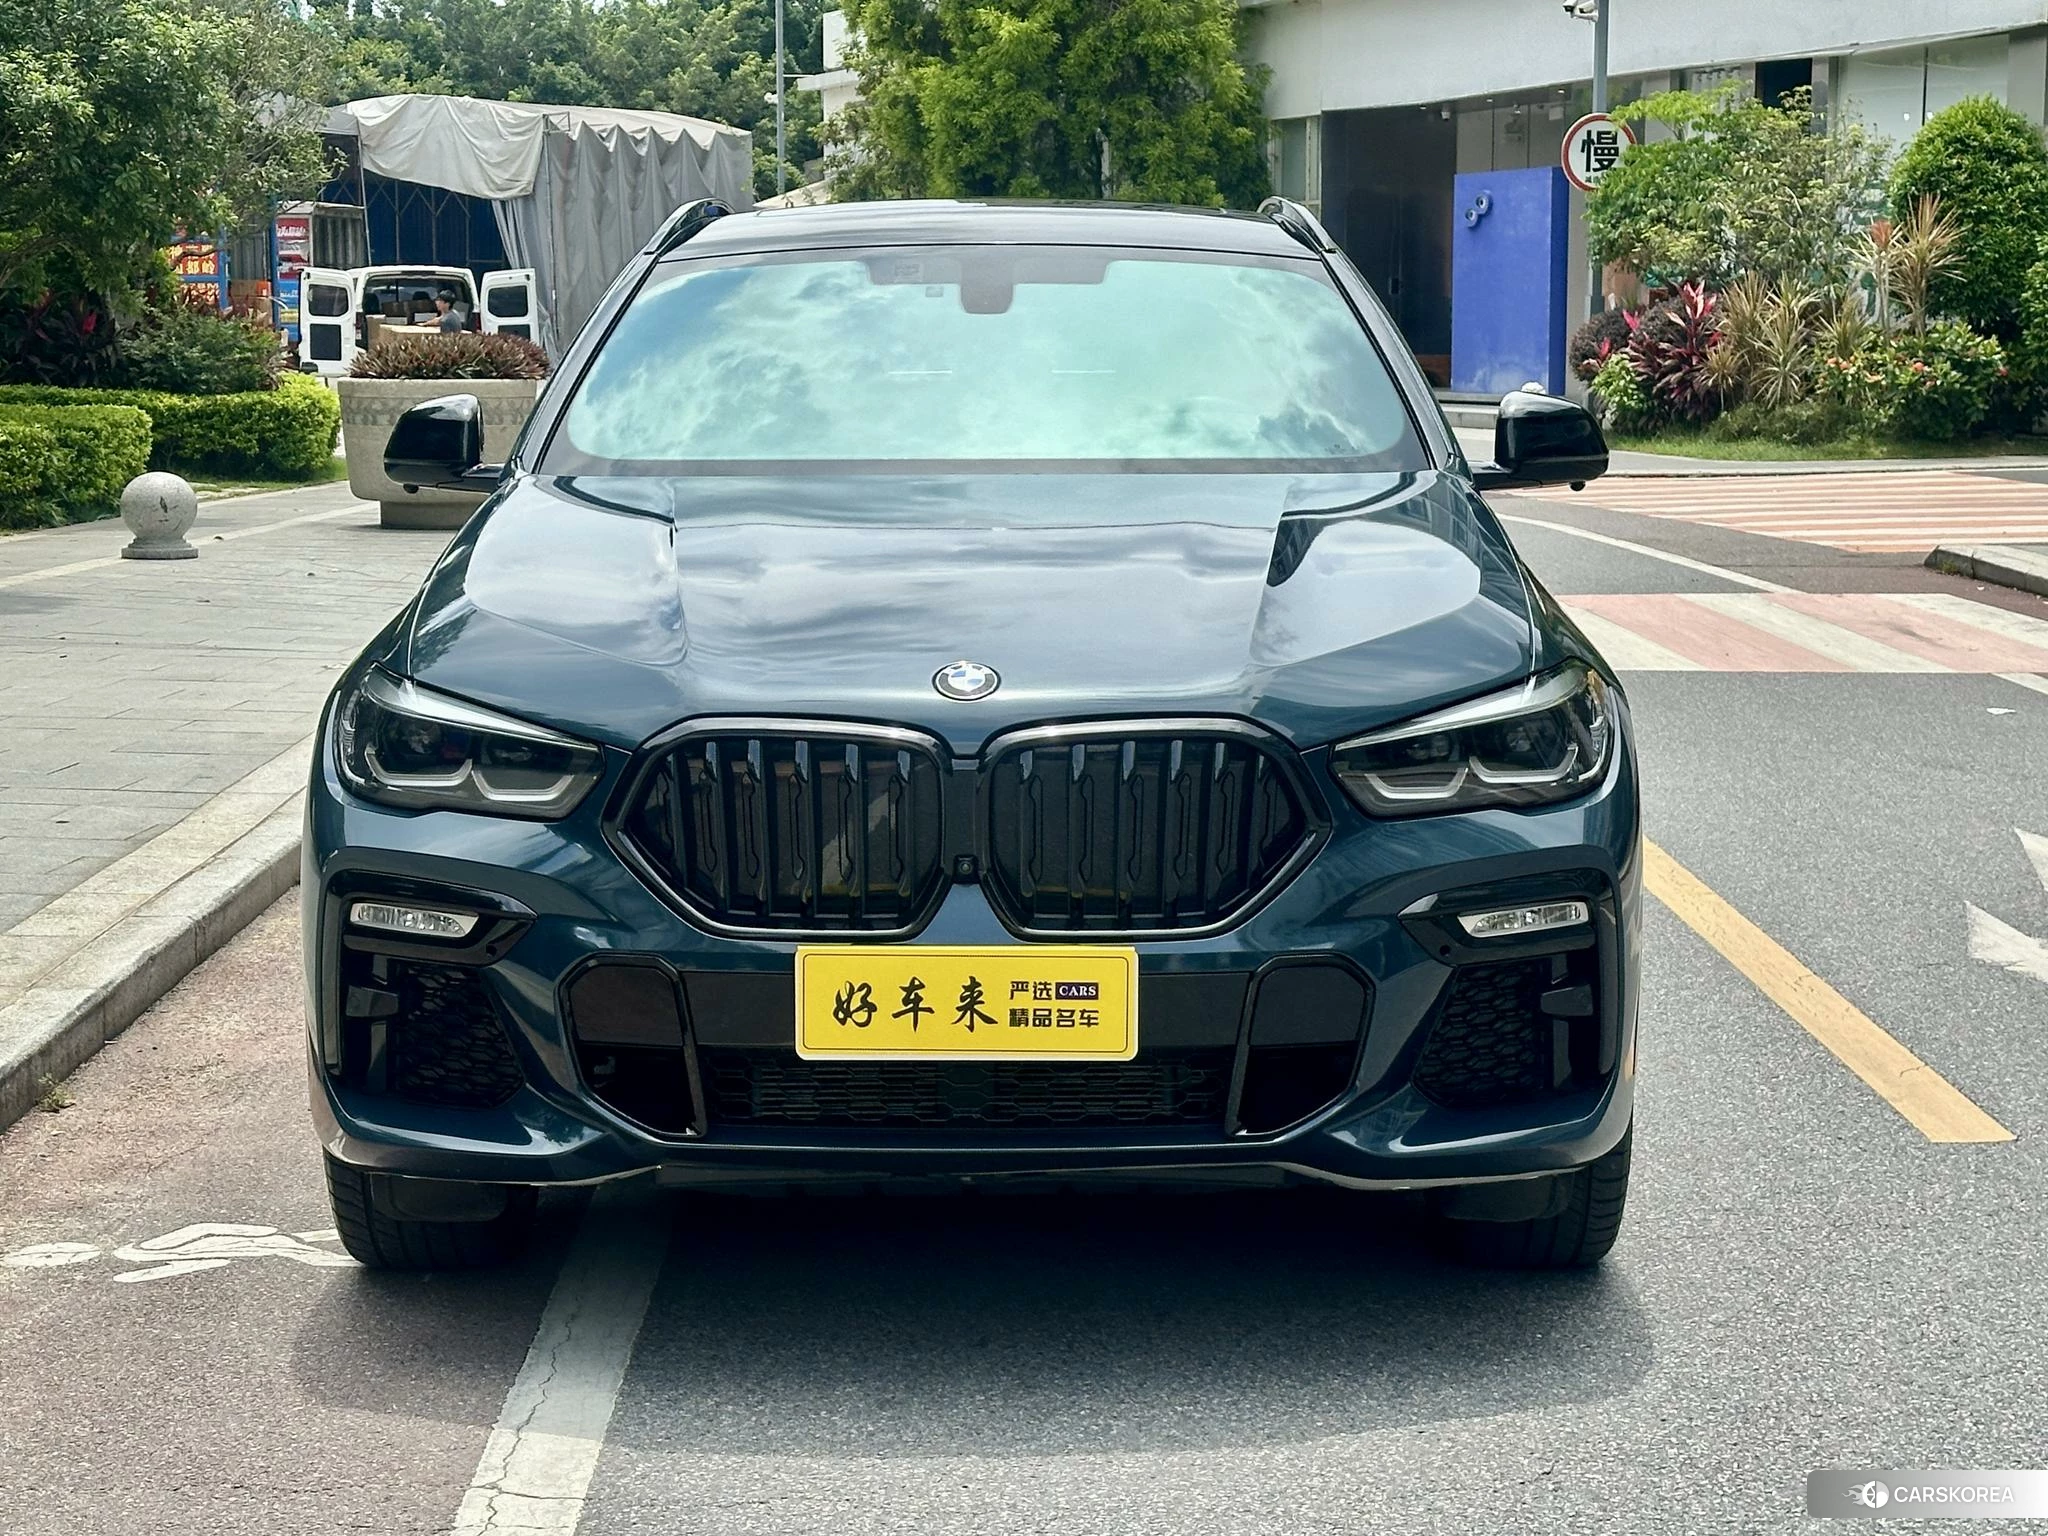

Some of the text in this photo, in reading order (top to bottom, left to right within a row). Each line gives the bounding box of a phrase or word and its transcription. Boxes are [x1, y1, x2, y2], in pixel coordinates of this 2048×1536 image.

[1581, 130, 1619, 172] 慢
[832, 976, 998, 1033] 好车来
[1010, 981, 1096, 1000] 严选 CARS
[1009, 1009, 1099, 1027] 精品名车
